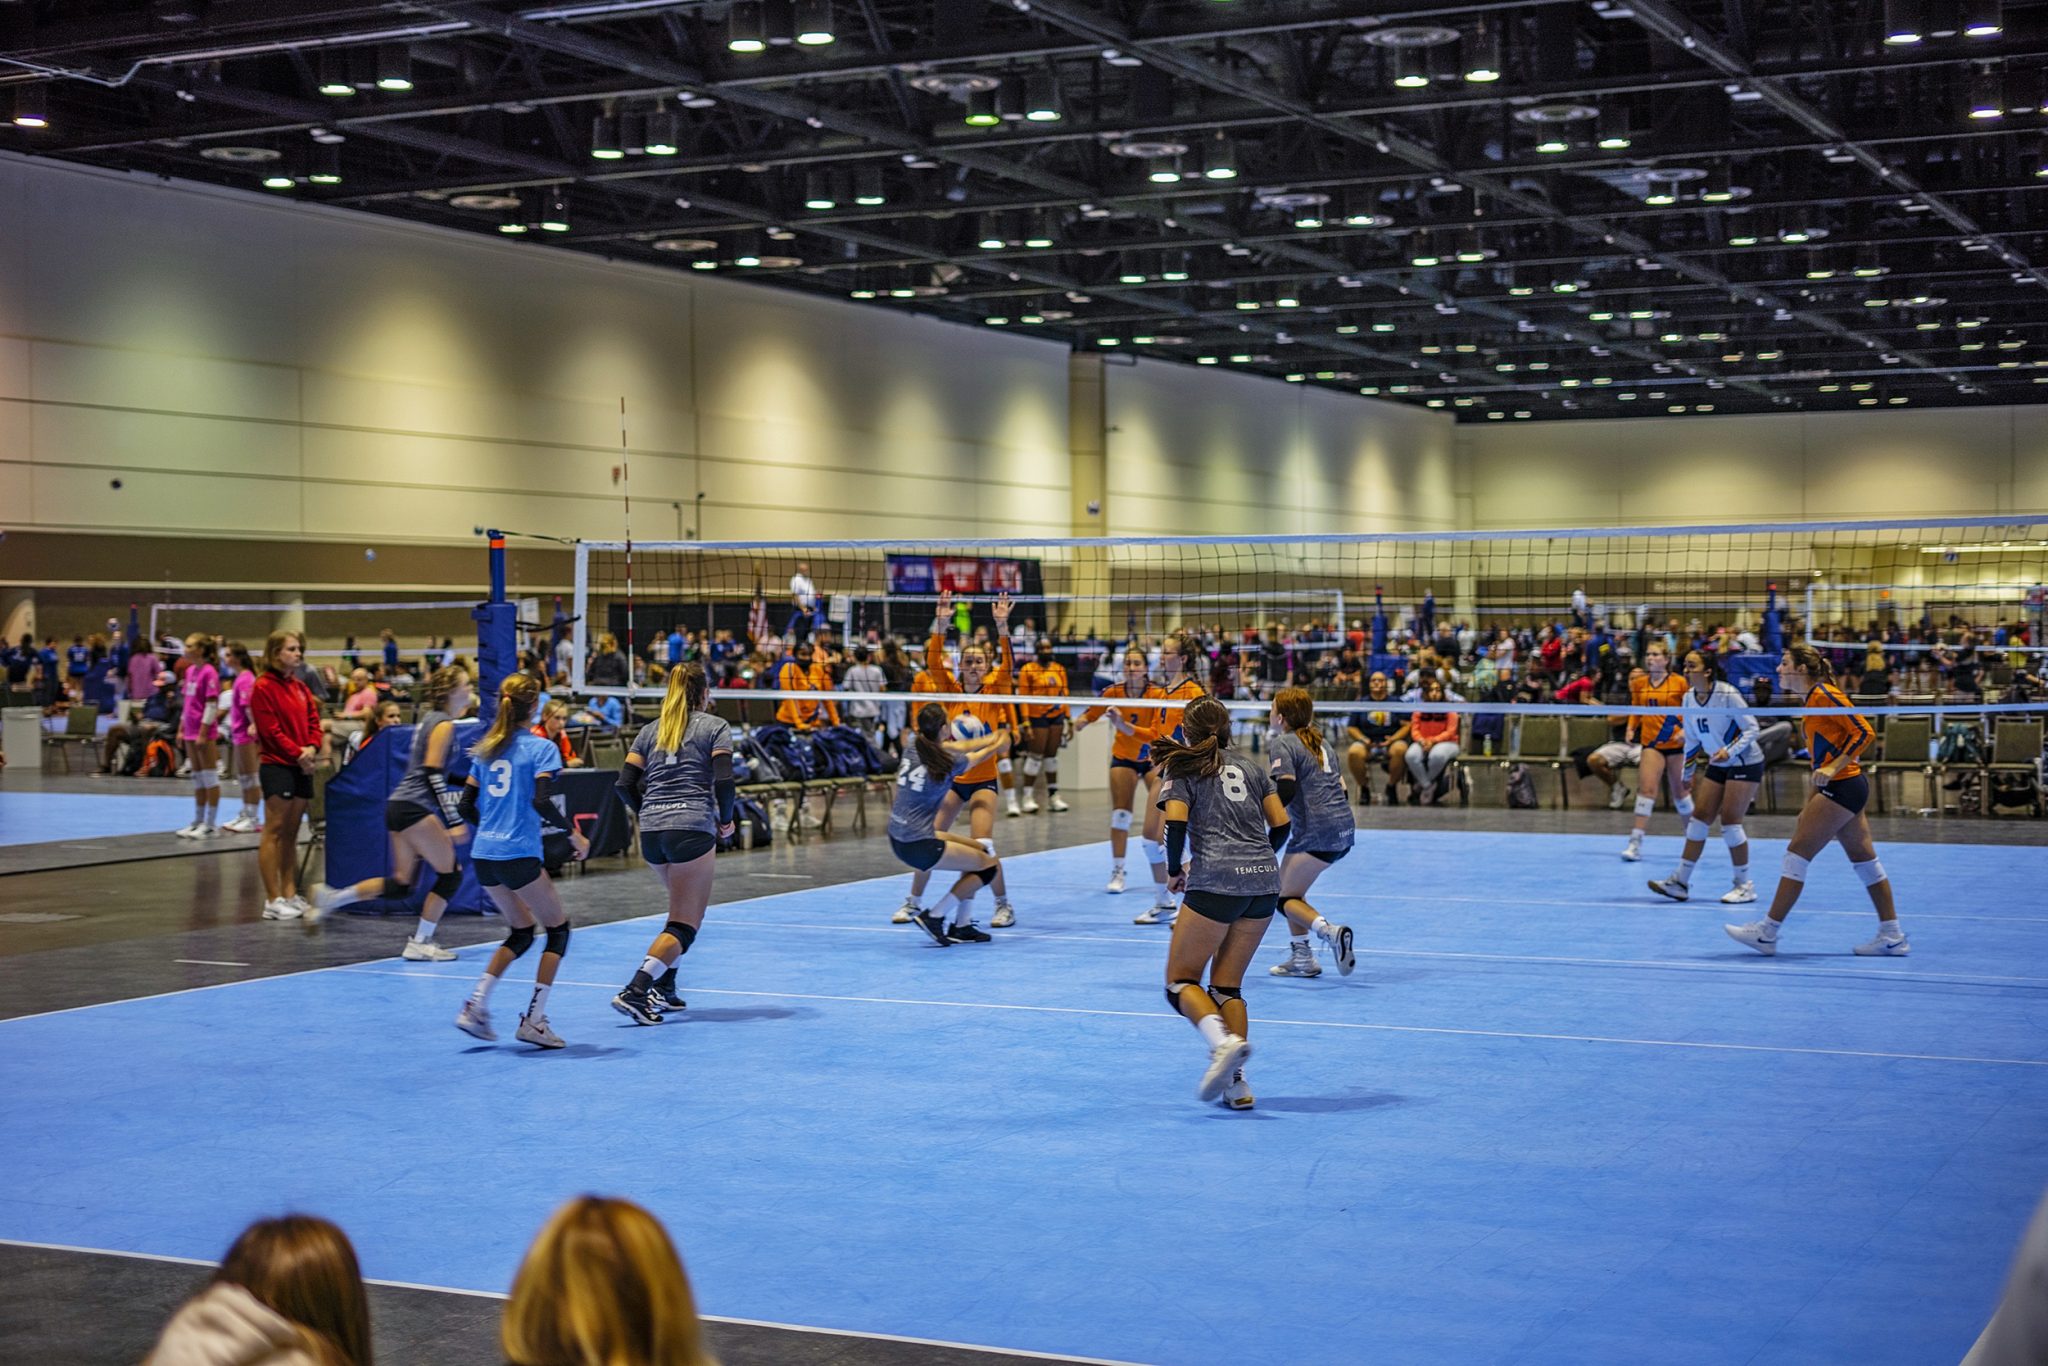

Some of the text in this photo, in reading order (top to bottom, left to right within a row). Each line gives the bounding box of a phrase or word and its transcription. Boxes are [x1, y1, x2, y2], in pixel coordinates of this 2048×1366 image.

[488, 759, 512, 797] 3
[898, 757, 928, 793] 24
[1218, 764, 1248, 802] 8
[1234, 865, 1279, 875] TEMECULA
